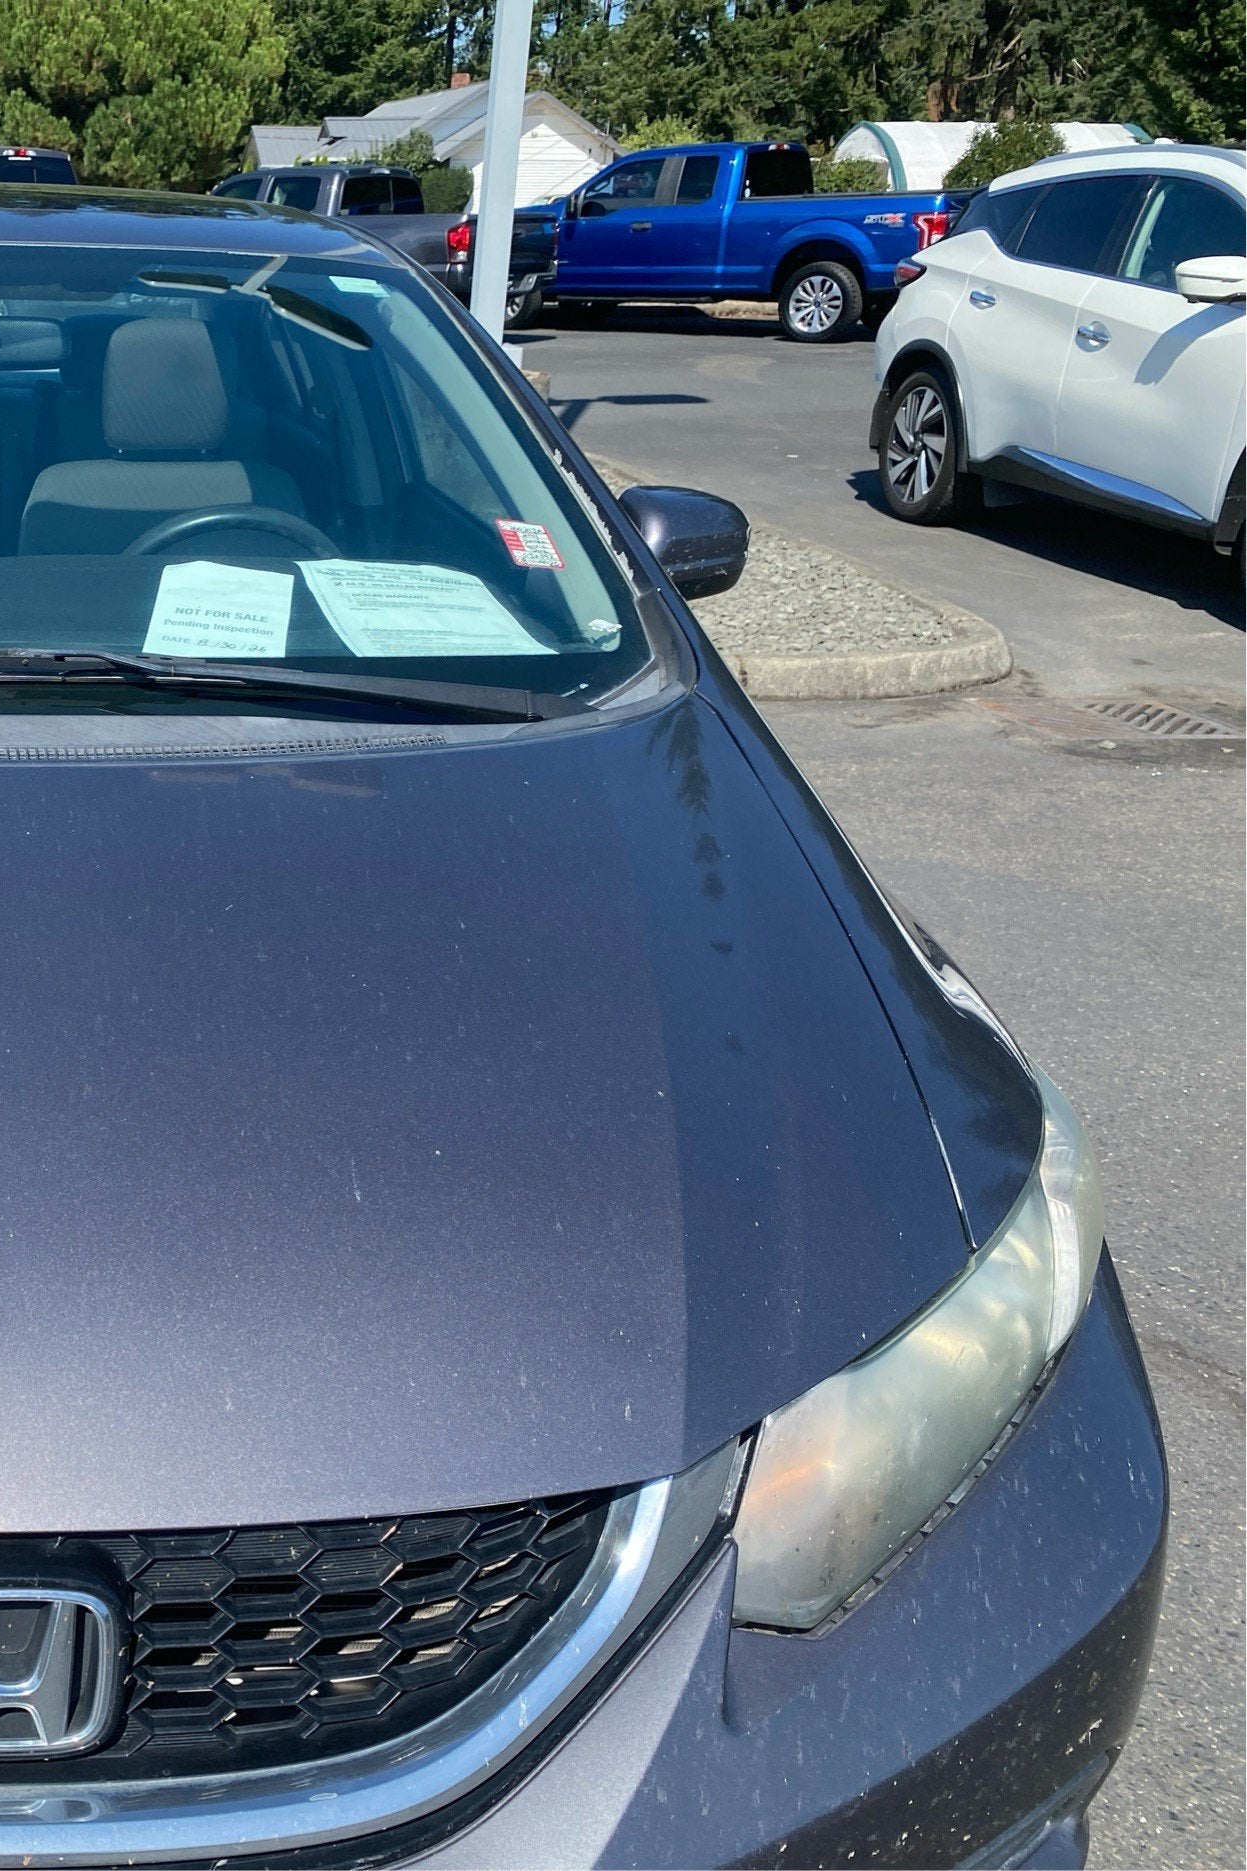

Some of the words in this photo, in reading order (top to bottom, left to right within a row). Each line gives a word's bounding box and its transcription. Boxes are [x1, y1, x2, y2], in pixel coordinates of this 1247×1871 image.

[174, 607, 202, 616] NOT
[205, 609, 231, 619] FOR
[234, 612, 269, 623] SALE
[163, 618, 210, 630] Pending
[213, 622, 274, 636] Inspection
[161, 635, 191, 644] DATE
